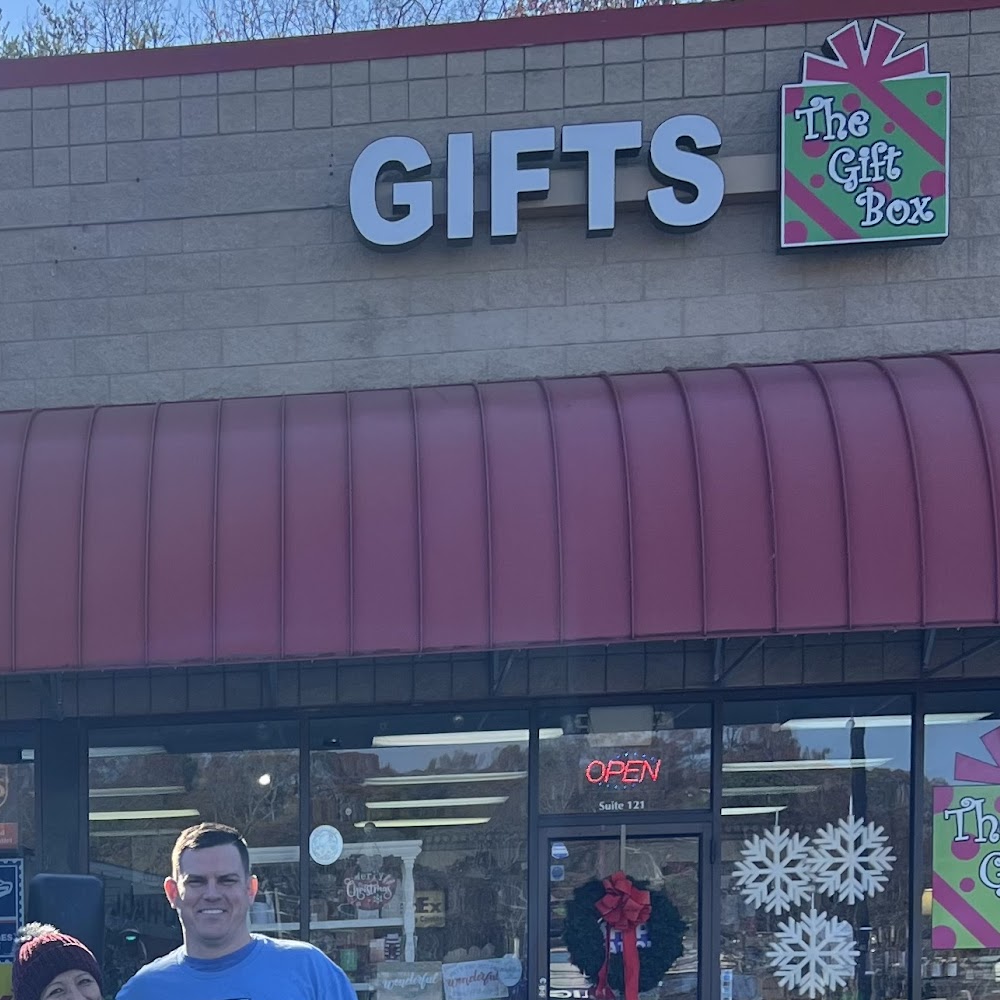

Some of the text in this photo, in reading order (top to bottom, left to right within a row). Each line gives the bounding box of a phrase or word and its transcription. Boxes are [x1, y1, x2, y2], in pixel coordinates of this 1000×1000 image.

[795, 96, 870, 141] The
[349, 114, 725, 247] GIFTS
[827, 140, 902, 192] Gift
[855, 186, 935, 227] Box
[585, 759, 662, 783] OPEN
[598, 800, 645, 811] Suite 121
[944, 796, 1000, 843] Th
